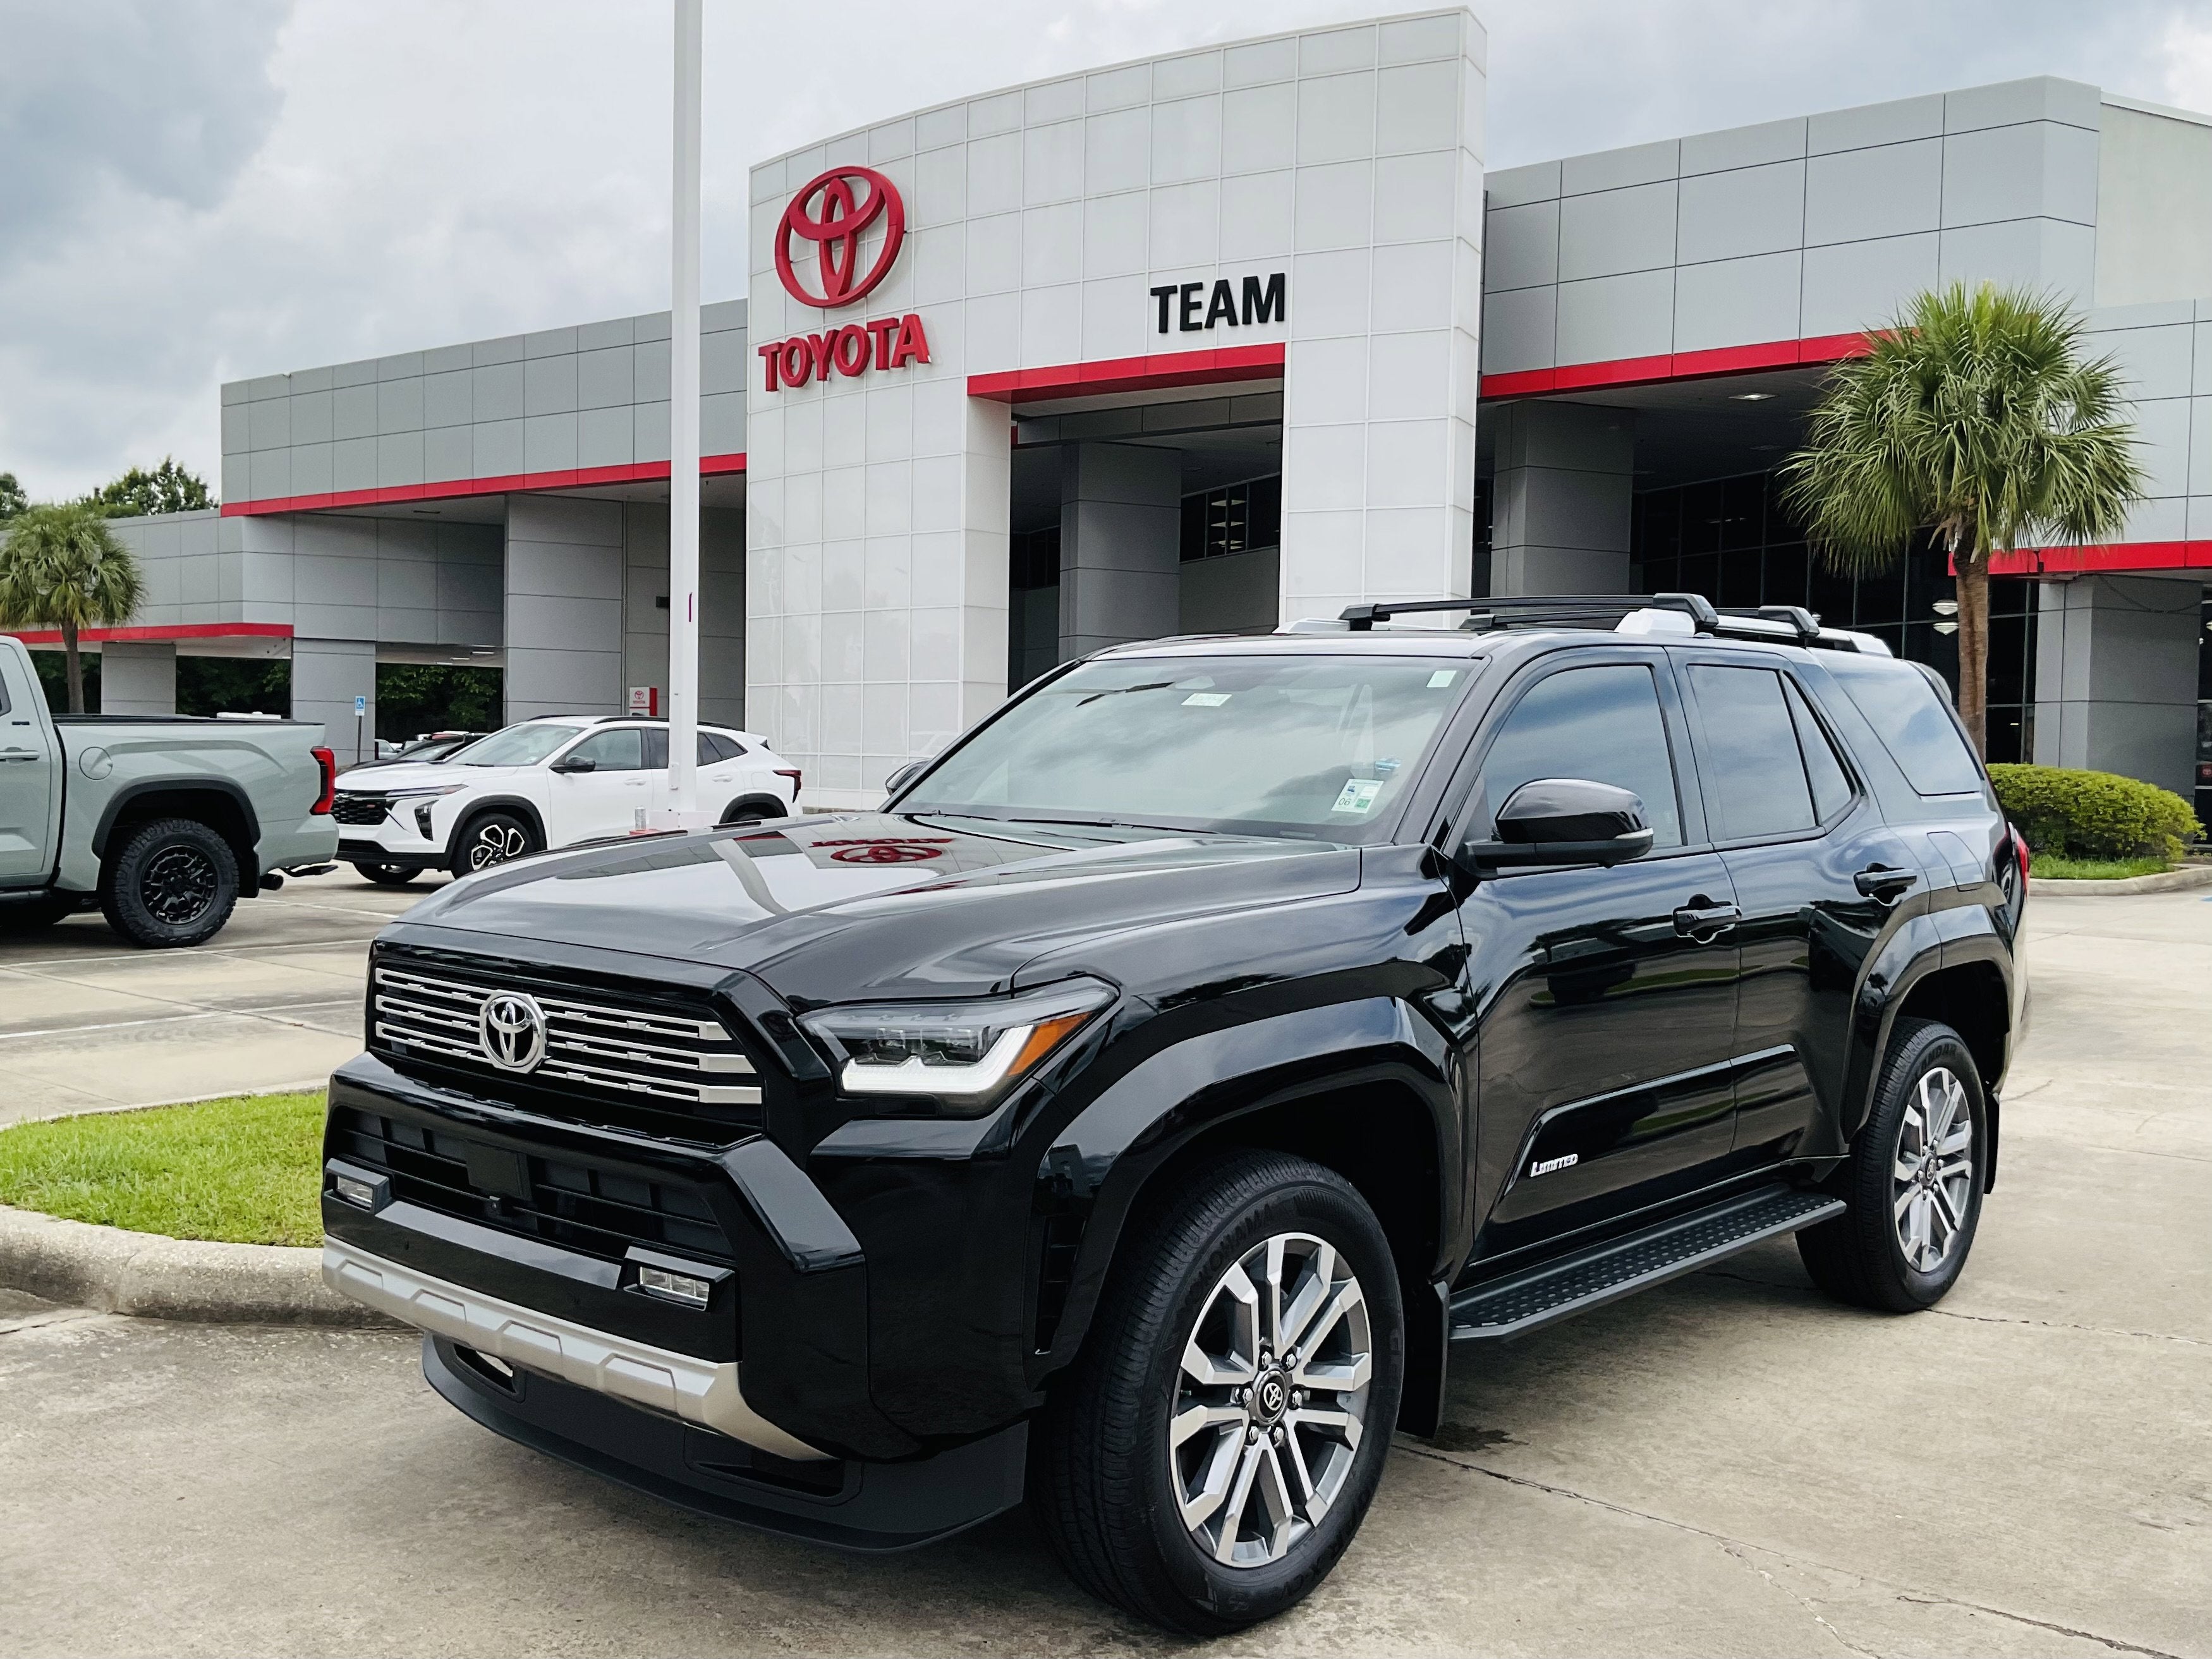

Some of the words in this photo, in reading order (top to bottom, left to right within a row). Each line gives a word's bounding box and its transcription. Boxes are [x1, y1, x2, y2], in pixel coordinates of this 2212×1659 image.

[1150, 272, 1285, 333] TEAM
[758, 313, 931, 391] TOYOTA
[1338, 798, 1352, 806] 06
